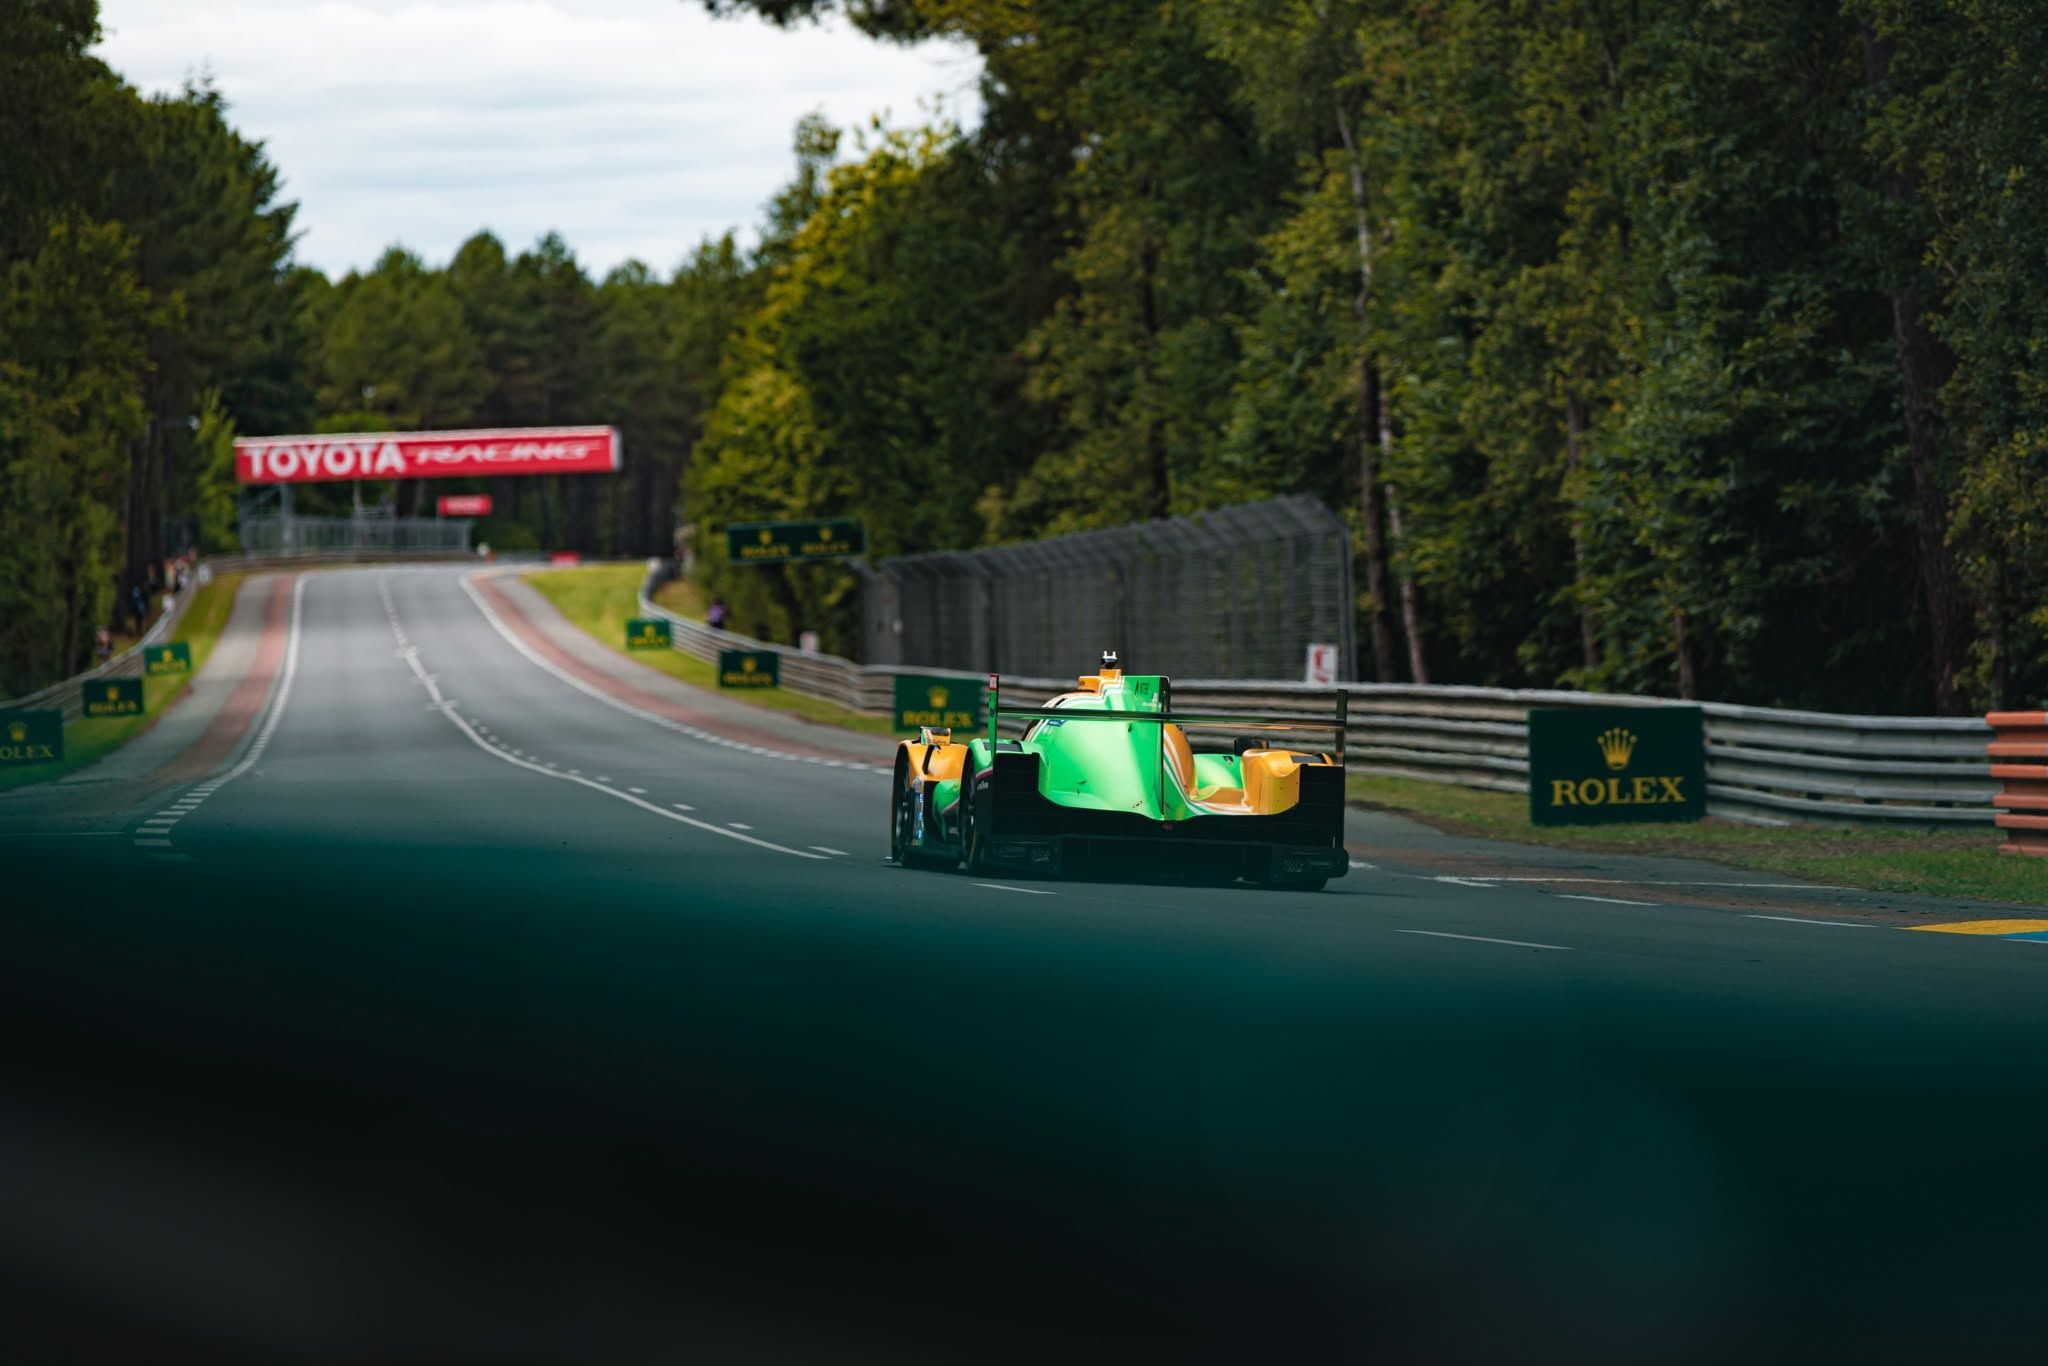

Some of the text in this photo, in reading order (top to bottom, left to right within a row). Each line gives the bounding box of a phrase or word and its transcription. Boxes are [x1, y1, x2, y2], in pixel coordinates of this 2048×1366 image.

[243, 441, 599, 479] TOYOTA RACING
[0, 744, 54, 760] OLEX
[1551, 776, 1686, 807] ROLEX
